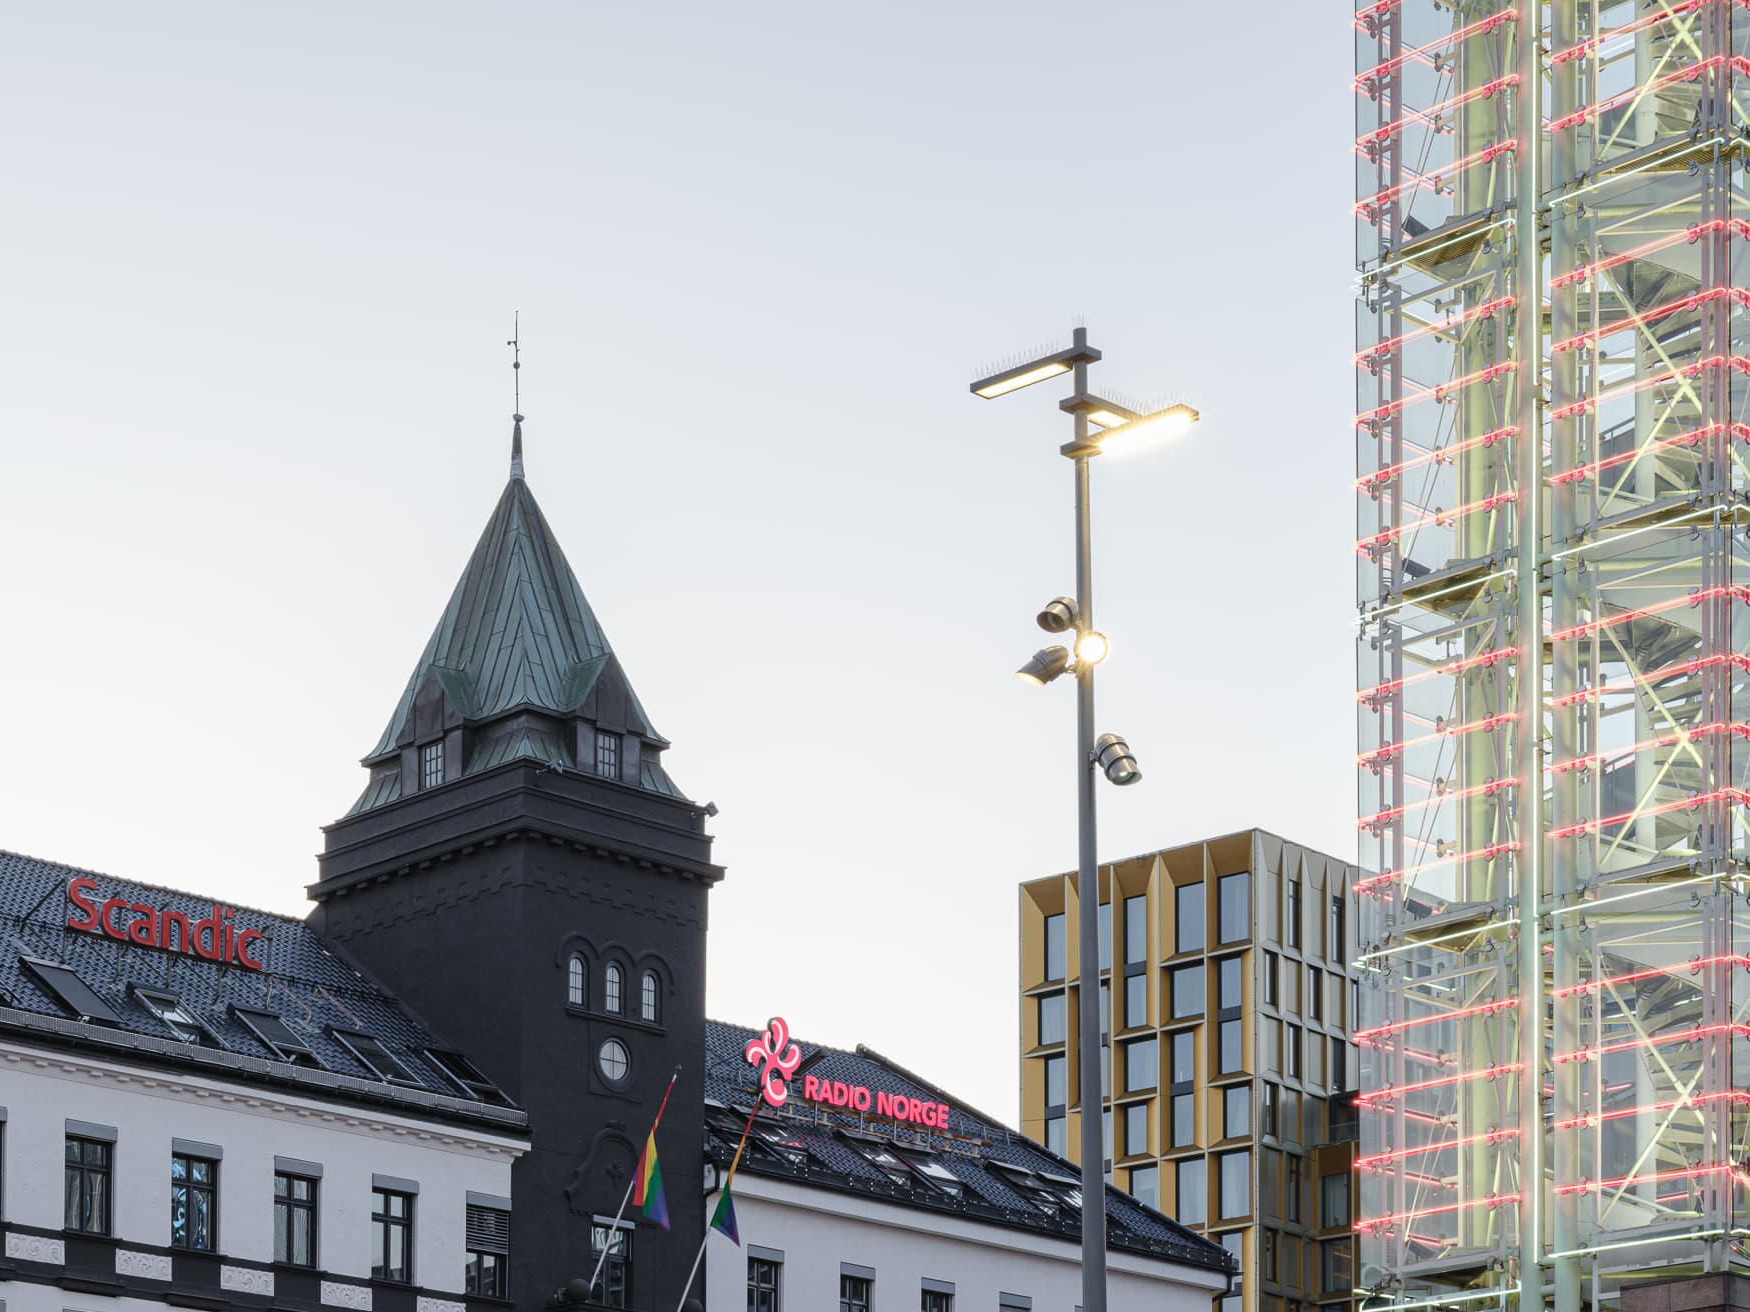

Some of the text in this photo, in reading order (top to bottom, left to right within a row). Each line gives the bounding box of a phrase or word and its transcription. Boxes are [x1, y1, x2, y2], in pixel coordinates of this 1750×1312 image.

[67, 877, 263, 969] Scandic
[804, 1074, 950, 1130] RADIO NORGE
